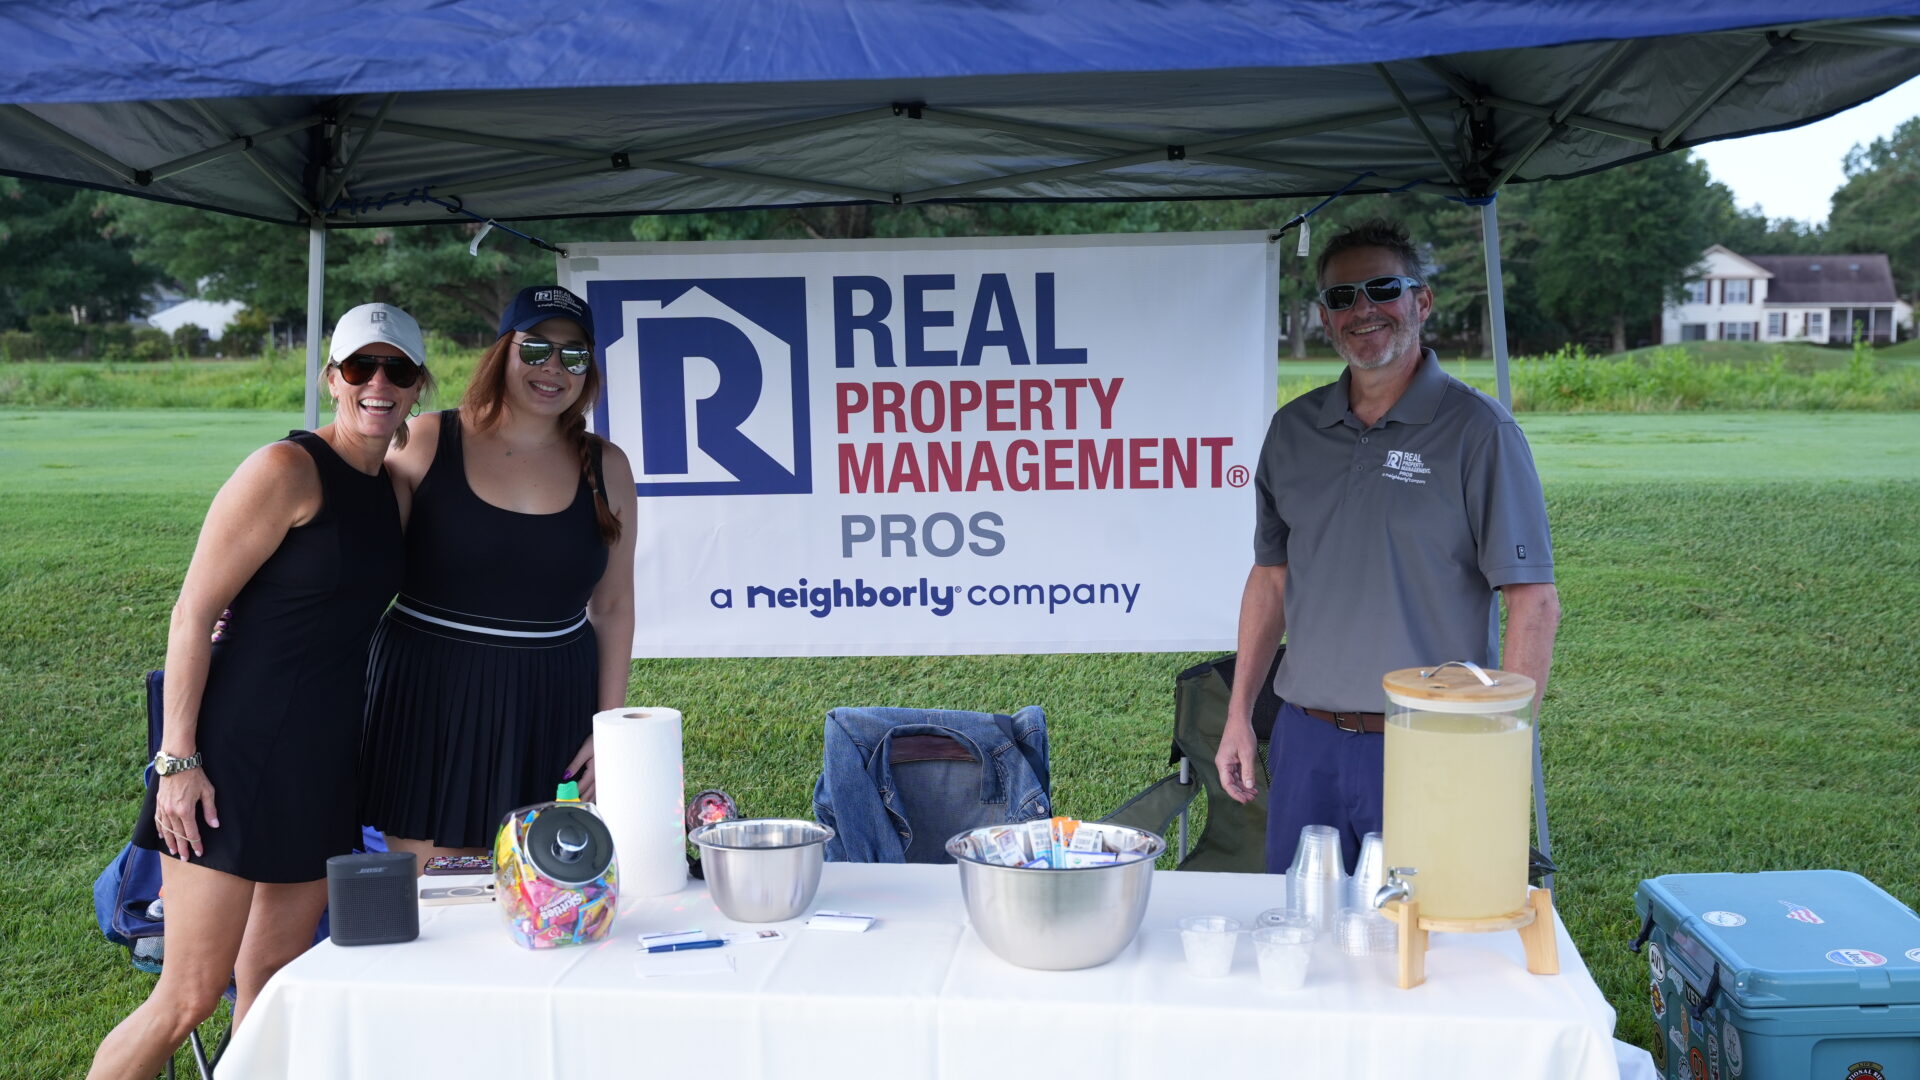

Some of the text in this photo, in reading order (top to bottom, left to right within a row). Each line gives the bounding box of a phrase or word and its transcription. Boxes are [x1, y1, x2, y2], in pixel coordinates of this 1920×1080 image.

[833, 272, 1087, 368] REAL
[637, 316, 796, 482] R
[835, 378, 1125, 434] PROPERTY
[1404, 452, 1422, 463] REAL
[841, 510, 1006, 559] PROS
[710, 588, 733, 610] a
[967, 583, 1140, 615] company
[540, 893, 582, 920] Skittles
[1849, 1069, 1872, 1080] TIONAL
